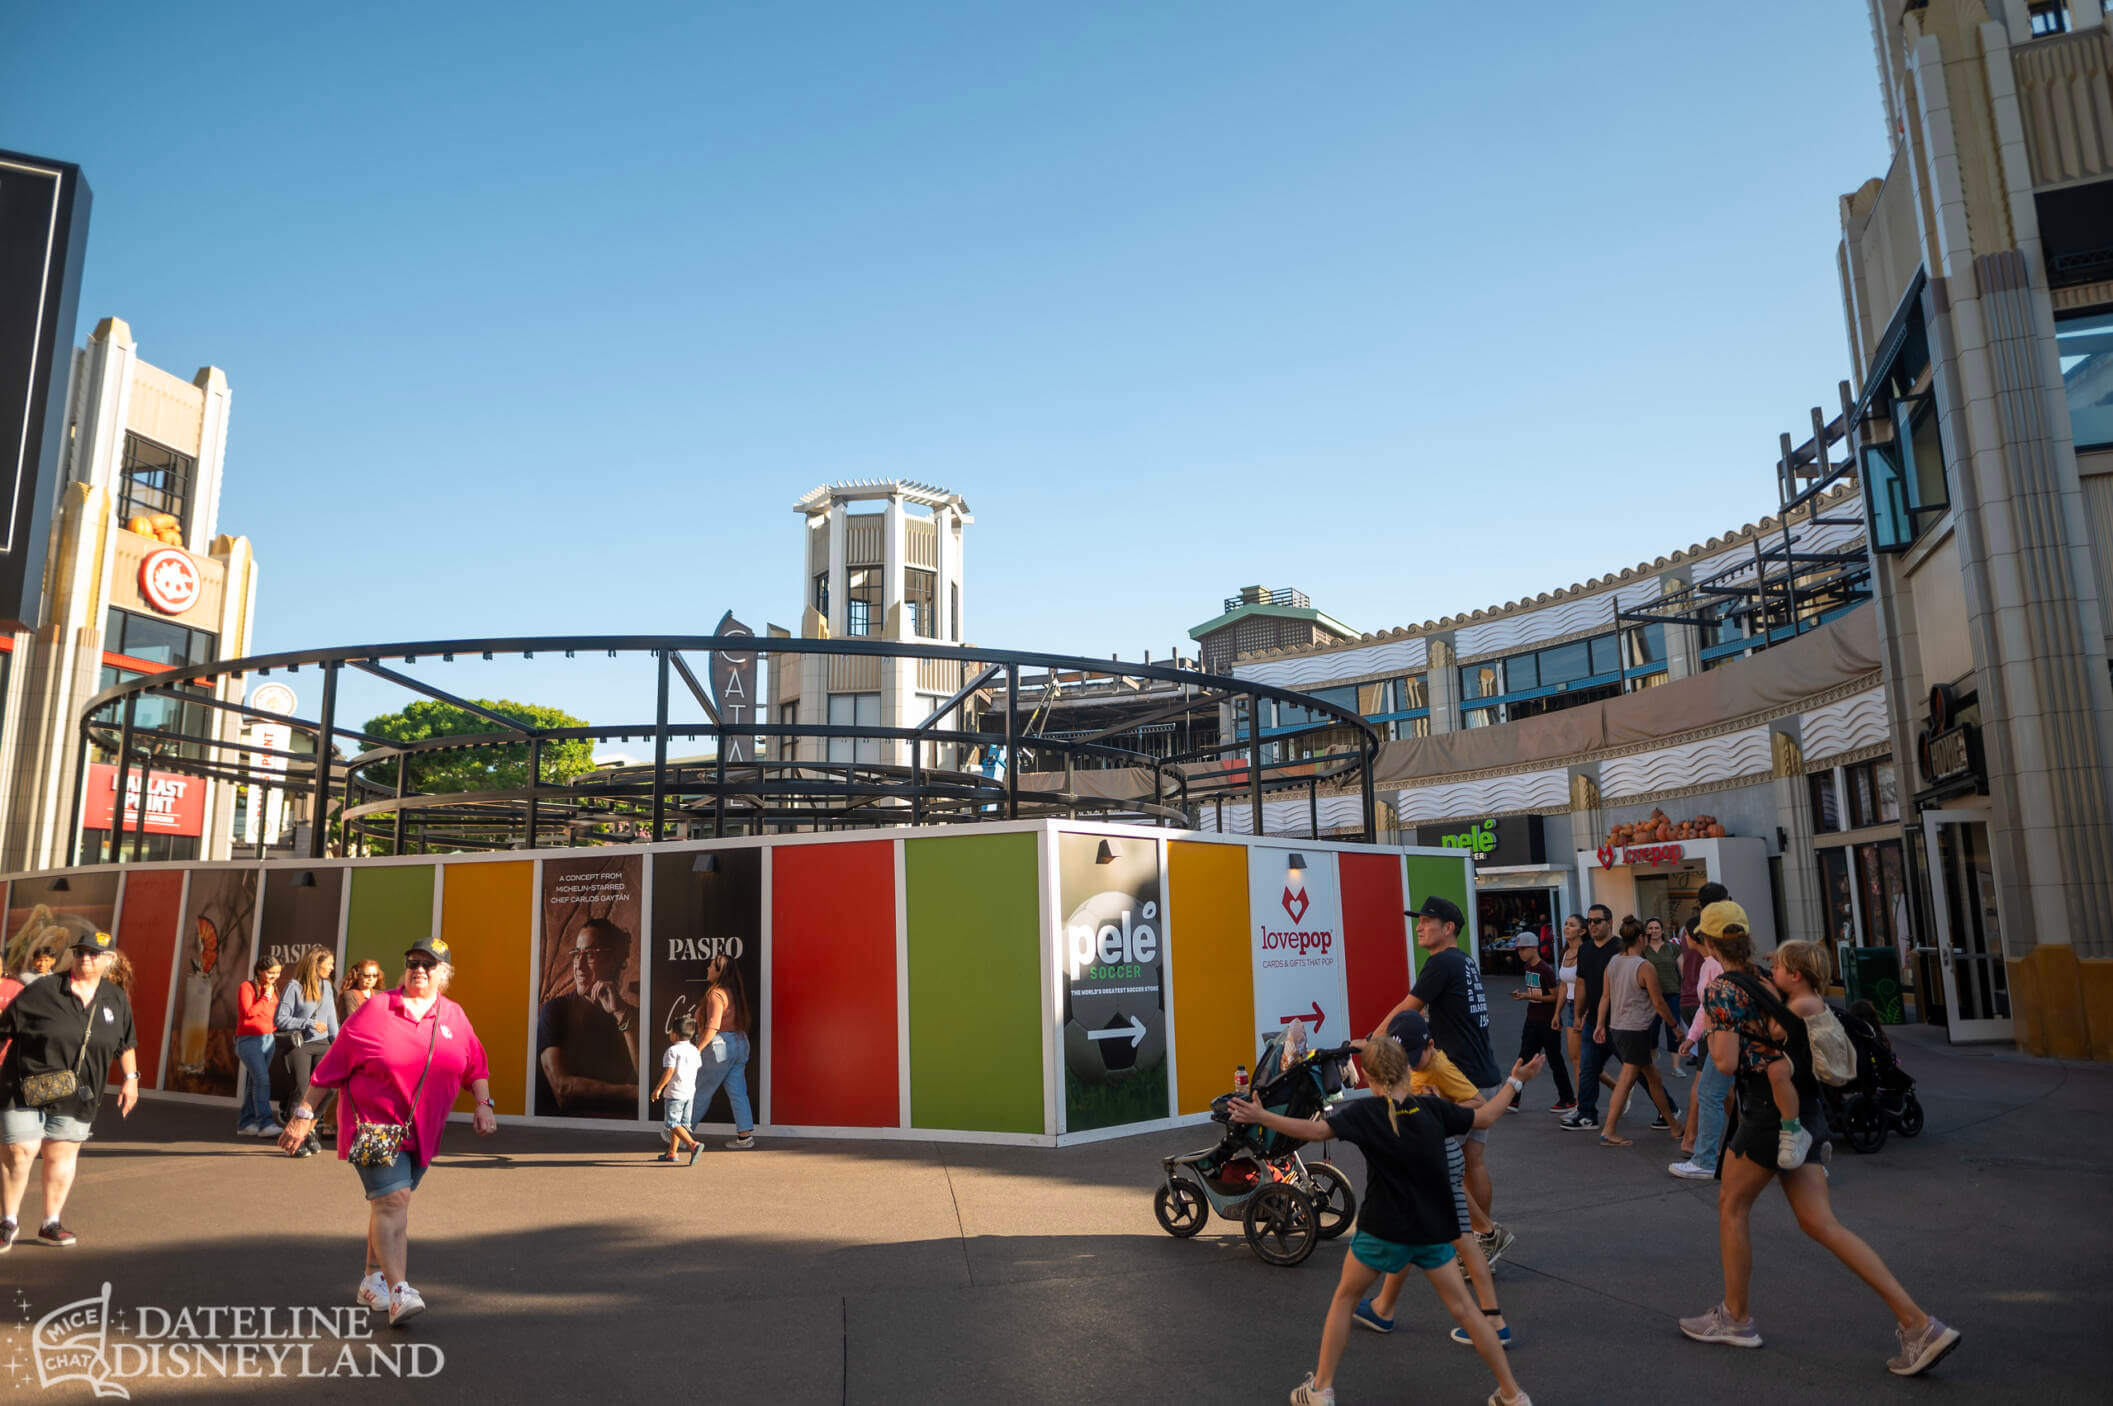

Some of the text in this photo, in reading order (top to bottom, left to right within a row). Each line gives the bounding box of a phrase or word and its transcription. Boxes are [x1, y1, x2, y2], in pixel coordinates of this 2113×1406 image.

[1621, 843, 1684, 867] lovepop
[565, 873, 600, 882] CONCEPT
[600, 872, 622, 880] FROM
[555, 883, 625, 893] MICHELIN-STARRED
[550, 896, 570, 904] CHEF
[570, 895, 599, 903] CARLOS
[1261, 925, 1333, 955] lovepop
[668, 936, 744, 961] PASEO
[1262, 960, 1284, 969] CARDS
[1289, 959, 1306, 968] GIFTS
[1306, 958, 1321, 967] THAT
[1321, 957, 1334, 966] POP
[1089, 965, 1142, 980] SOCCER
